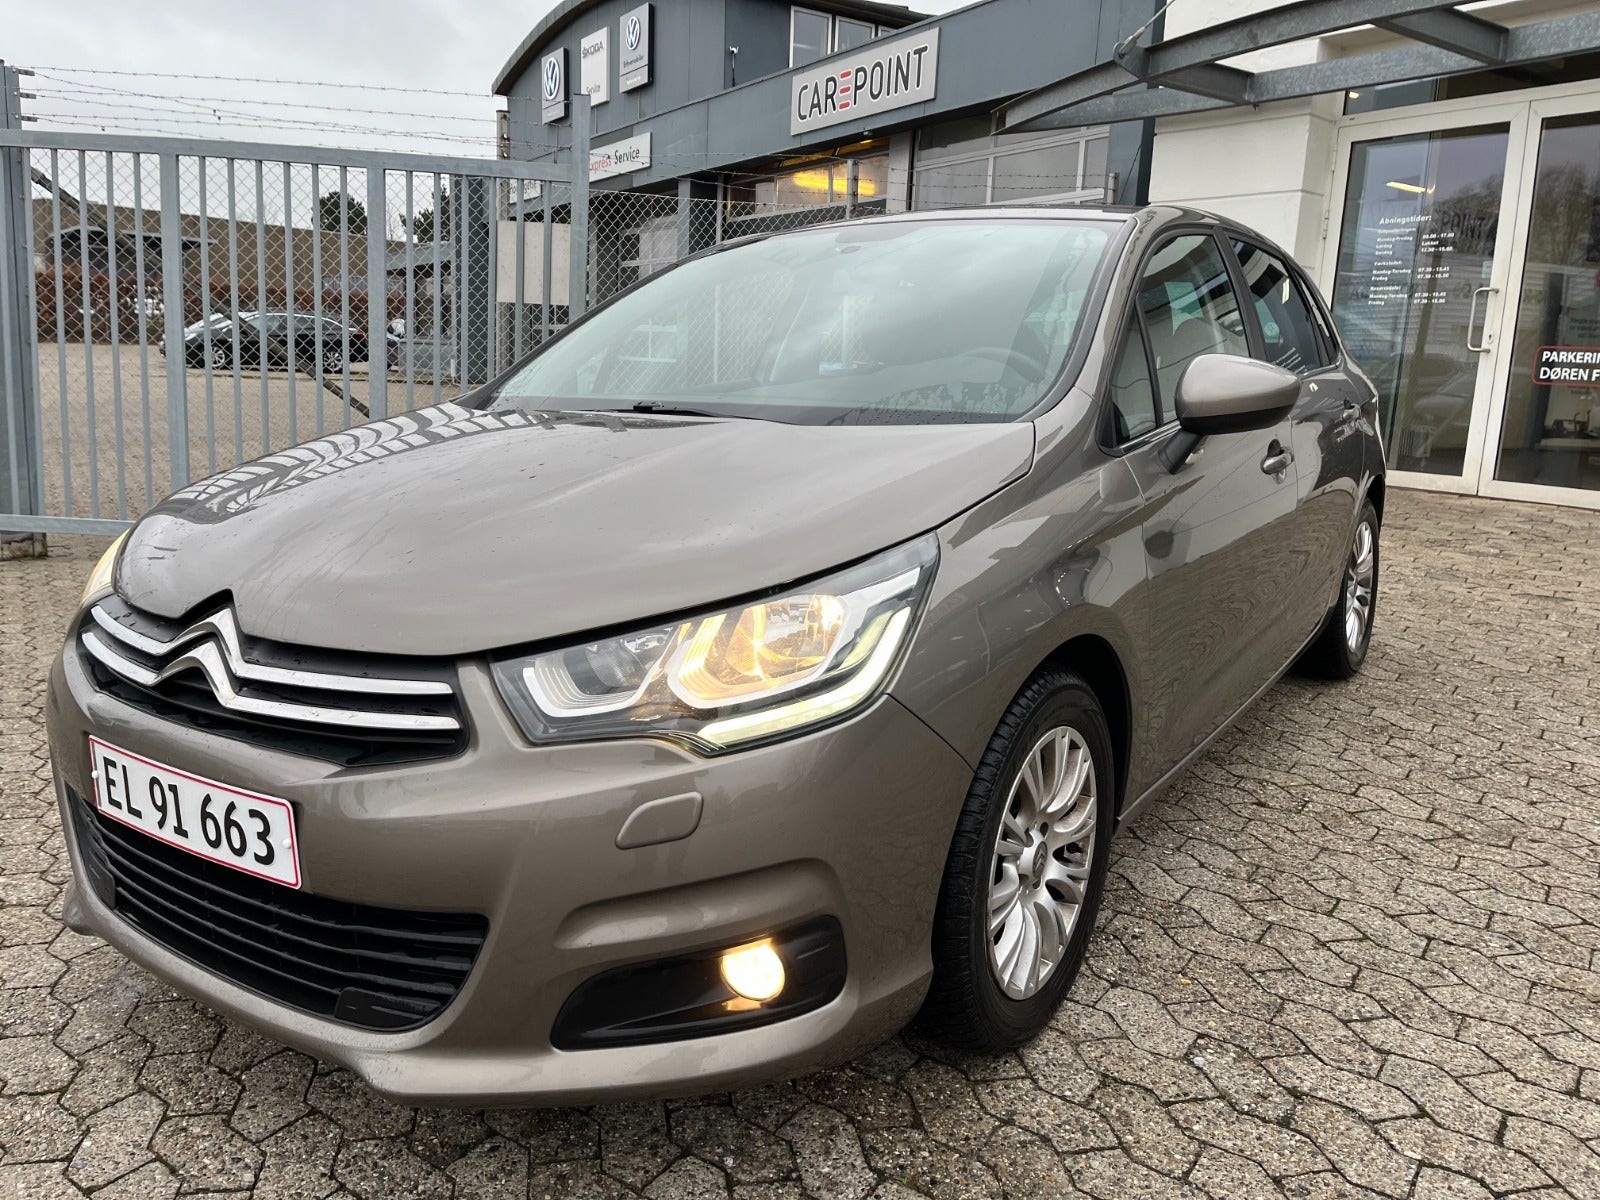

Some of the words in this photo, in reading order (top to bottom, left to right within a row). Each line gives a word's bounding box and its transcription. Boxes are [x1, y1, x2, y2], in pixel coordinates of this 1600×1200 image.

[797, 44, 929, 121] CAREPOINT
[588, 156, 612, 174] xpress
[614, 146, 640, 165] Service
[1539, 367, 1590, 381] DØREN
[102, 755, 143, 820] EL
[148, 775, 189, 839] 91
[199, 793, 275, 866] 663
